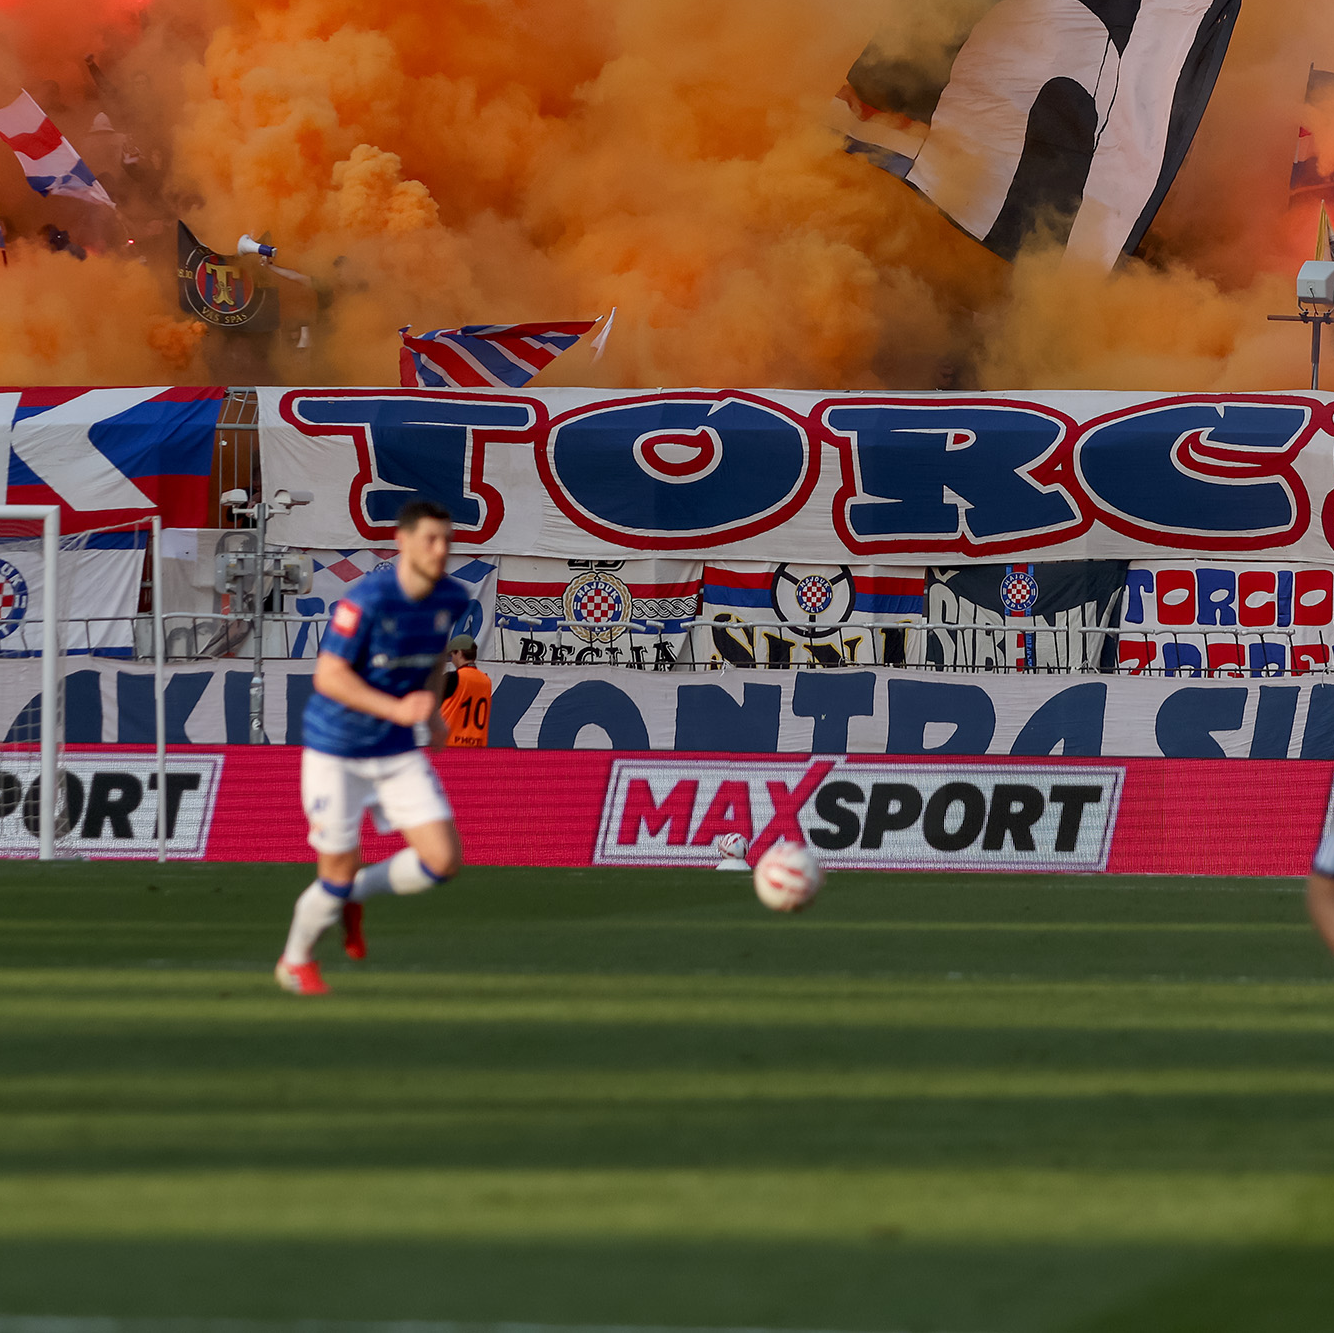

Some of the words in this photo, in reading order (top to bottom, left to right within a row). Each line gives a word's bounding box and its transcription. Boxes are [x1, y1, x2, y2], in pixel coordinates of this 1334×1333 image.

[1003, 574, 1034, 588] HAJDUK
[576, 581, 619, 600] HAJDUK
[801, 603, 825, 614] SPLIT
[1004, 598, 1033, 610] SPLIT
[460, 696, 488, 730] 10
[454, 735, 481, 745] PHOT
[616, 760, 1103, 865] MAXSPORT
